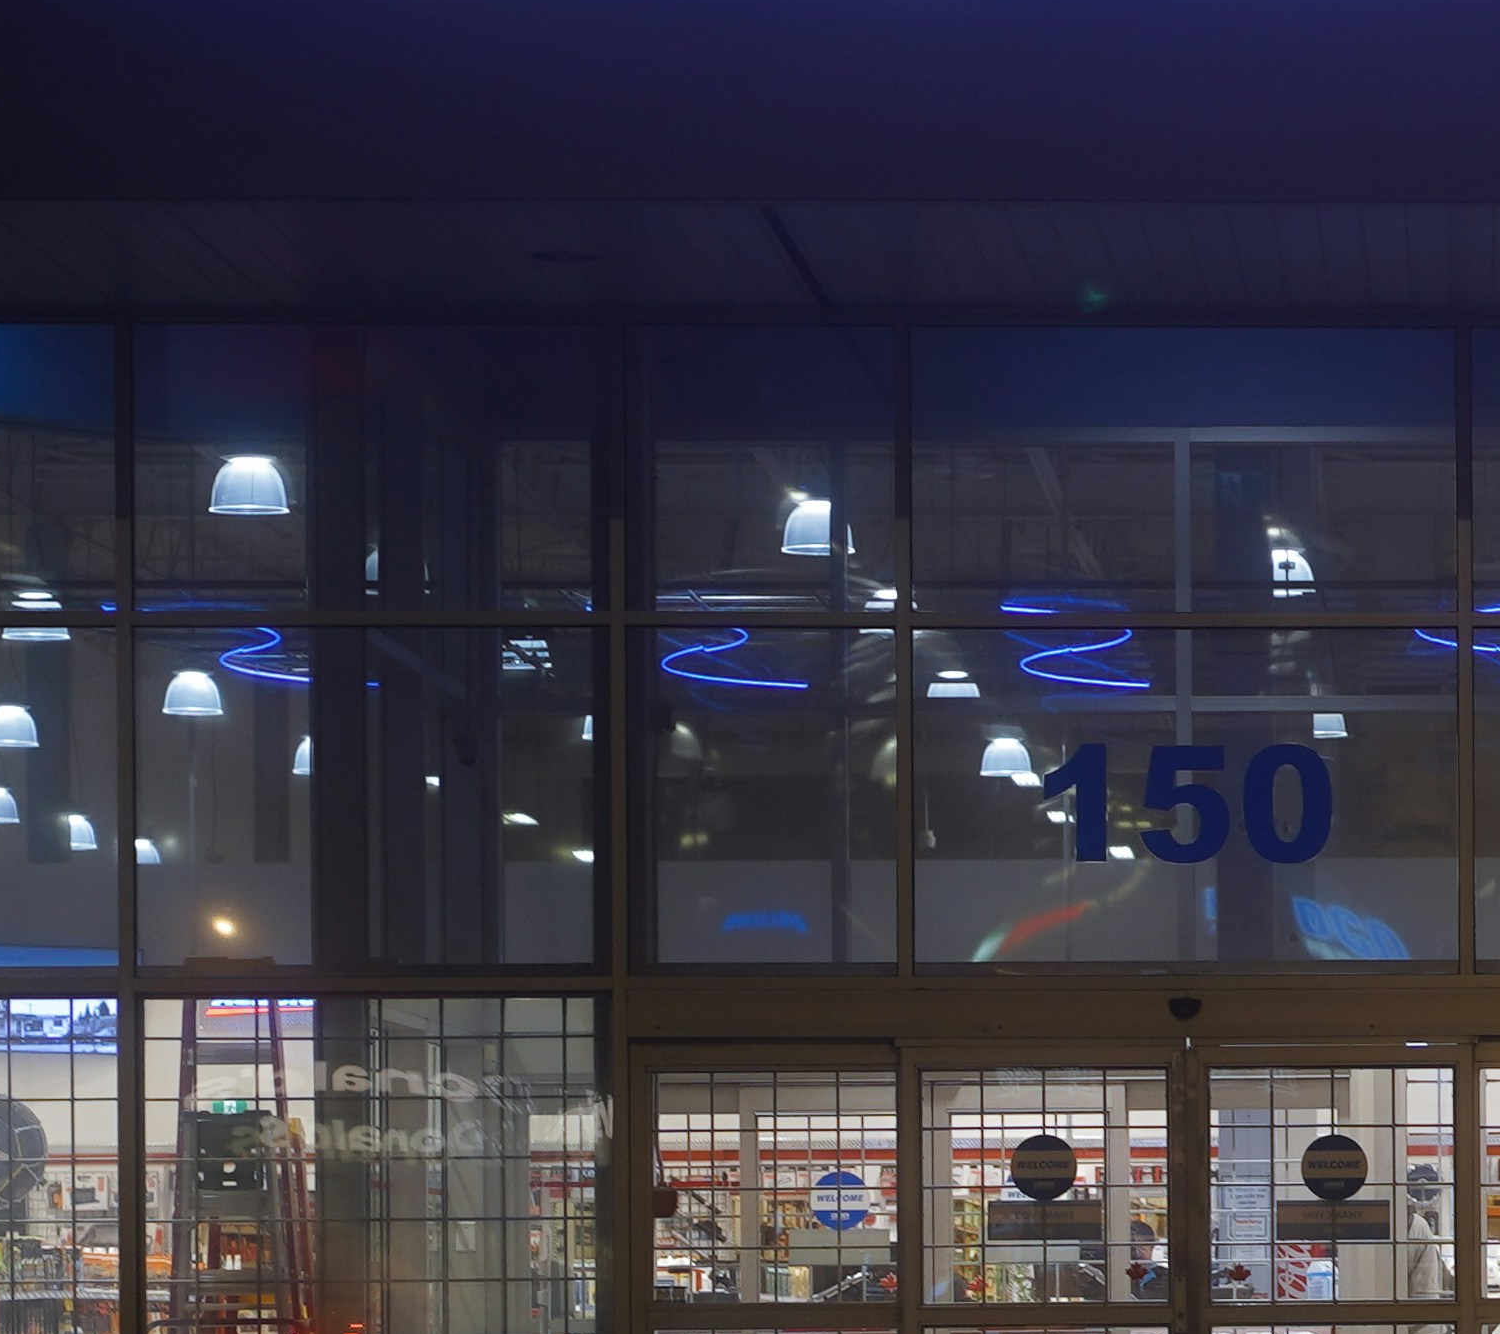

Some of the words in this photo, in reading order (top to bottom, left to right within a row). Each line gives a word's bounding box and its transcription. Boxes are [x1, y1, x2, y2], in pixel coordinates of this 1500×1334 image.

[1043, 743, 1332, 864] 150
[1018, 1160, 1071, 1169] WELCOME
[1308, 1160, 1361, 1169] WELCOME
